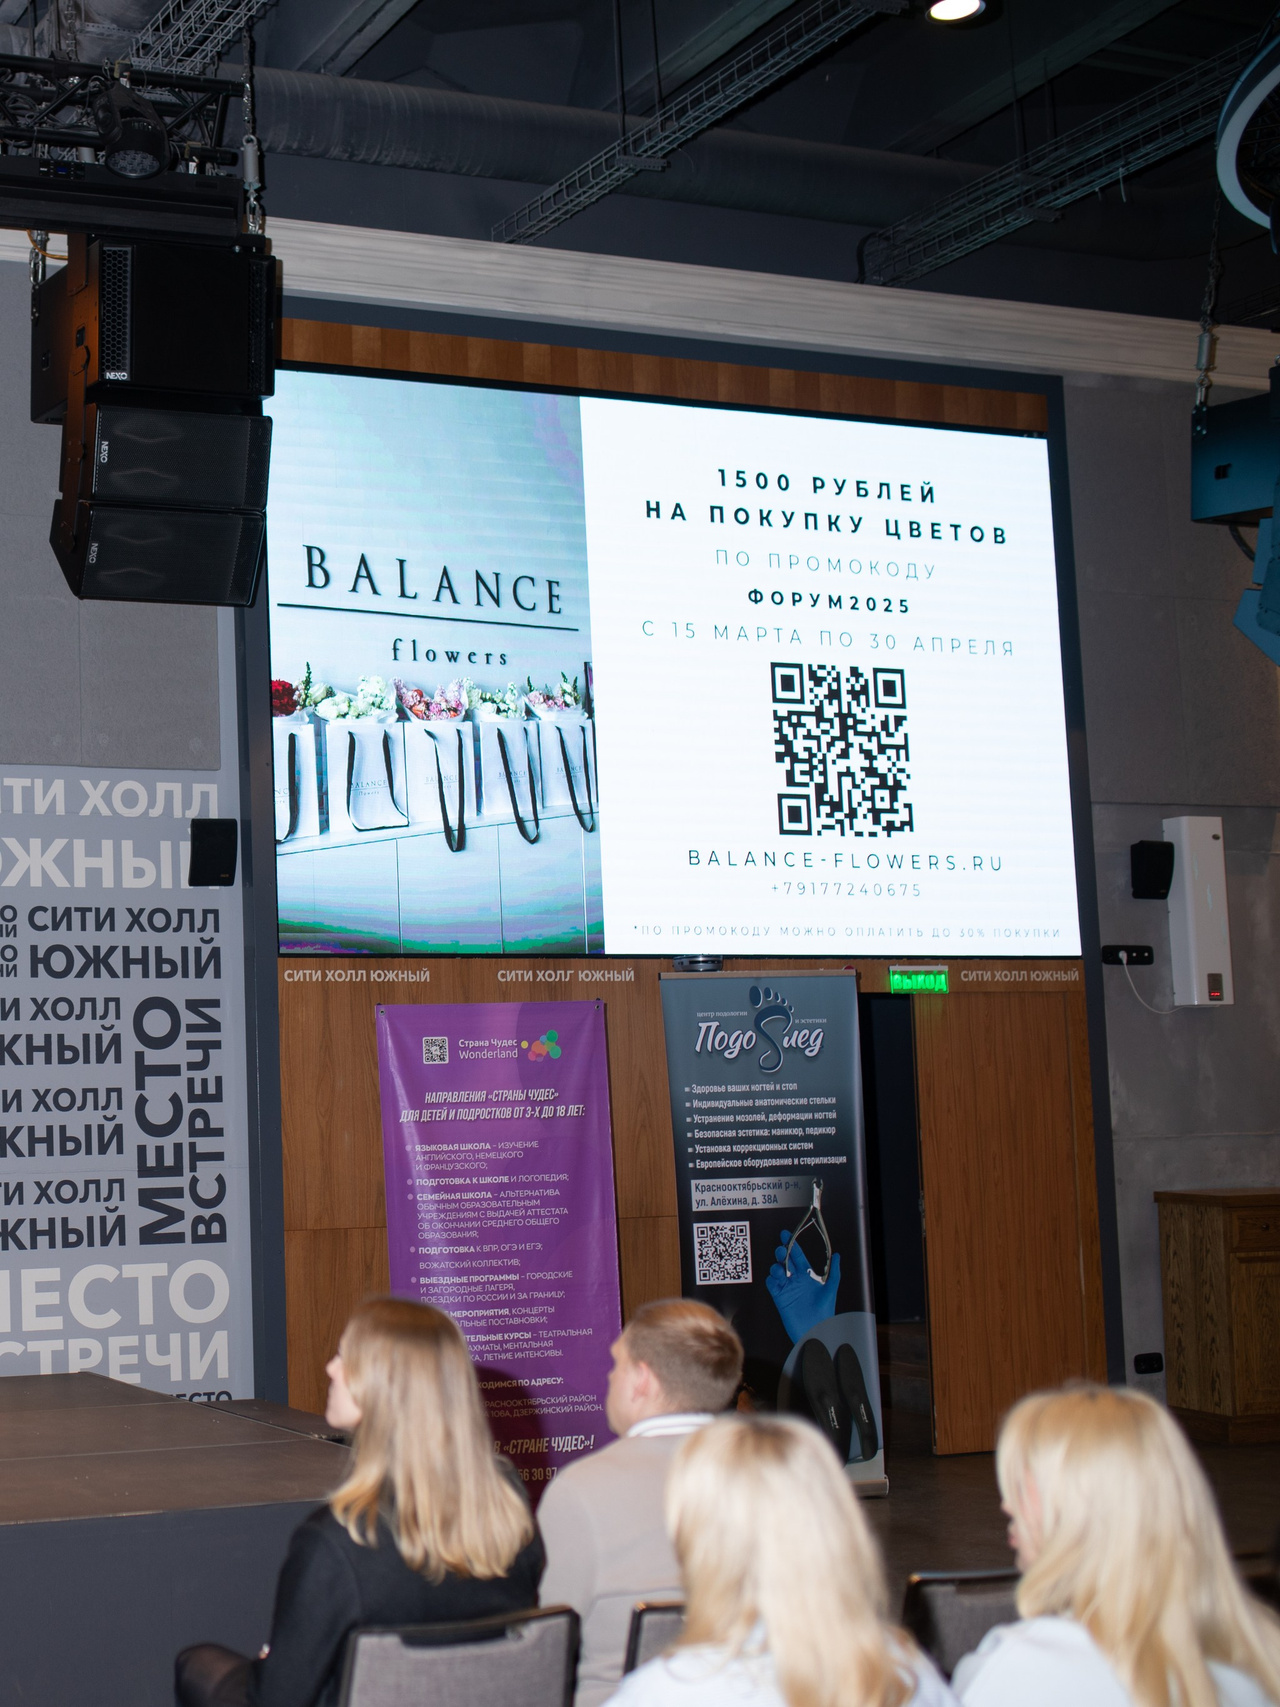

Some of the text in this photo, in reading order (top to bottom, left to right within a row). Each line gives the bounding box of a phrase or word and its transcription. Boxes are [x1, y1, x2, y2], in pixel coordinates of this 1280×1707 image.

[106, 371, 127, 380] NEXO
[100, 440, 109, 464] NEXO
[717, 468, 936, 504] 1500 РУБЛЕЙ
[646, 500, 1008, 545] НА ПОКУПКУ ЦВЕТОВ
[88, 542, 98, 564] NEXO
[715, 549, 936, 581] ПО ПРОМОКОДУ
[302, 544, 562, 614] BALANCE
[748, 588, 910, 613] ФОРУМ2025
[642, 620, 1014, 656] С 15 МАРТА ПО 30 АПРЕЛЯ
[391, 638, 507, 666] flowers
[79, 779, 219, 819] ХОЛЛ
[688, 849, 1003, 871] BALANCE-FLOWERS.RU
[771, 881, 921, 897] +79177240675
[28, 906, 220, 934] СИТИ ХОЛЛ
[671, 926, 770, 937] ПРОМОКОДУ
[780, 926, 836, 937] МОЖНО
[845, 927, 924, 938] ОПЛАТИТЬ
[932, 927, 951, 938] ДО
[993, 928, 1060, 938] ПОКУПКИ
[29, 936, 221, 979] ЮЖНЫЙ
[283, 967, 430, 983] СИТИ ХОЛЛ ЮЖНЫЙ
[497, 967, 635, 982] СИТИ ЮЖНЫЙ
[960, 968, 1080, 982] СИТИ ХОЛЛ ЮЖНЫЙ
[893, 973, 947, 991] ВЫХОД
[29, 996, 121, 1021] ХОЛЛ
[715, 1010, 748, 1018] подологии
[459, 1038, 518, 1049] Страна Чудес
[459, 1048, 518, 1060] Wonderland
[692, 1082, 797, 1094] Здоровье ваших ногтей стоп
[31, 1087, 123, 1112] ХОЛЛ
[425, 1088, 559, 1104] НАПРАВЛЕНИЯ «СТРАНЫ ЧУДЕС»
[692, 1096, 836, 1109] Индивидуальные анатомические стельки
[132, 996, 186, 1246] МЕСТО
[400, 1105, 586, 1123] ДЛЯ ДЕТЕЙ ПОДРОСТКОВ ОТ ДО 18 ЛЕТ:
[693, 1110, 837, 1124] Устранение мозолей, деформации ногтей
[184, 998, 227, 1245] ВСТРЕЧИ
[694, 1126, 836, 1138] Безопасная эстетика: маникюр, педикюр
[415, 1141, 539, 1152] ЯЗЫКОВАЯ ШКОЛА ИЗУЧЕНИЕ
[695, 1141, 813, 1154] Установка коррекционных систем
[415, 1151, 524, 1162] АНГЛИЙСКОГО, НЕМЕЦКОГО
[696, 1155, 847, 1170] Европейское оборудование стерилизация
[423, 1162, 488, 1172] ФРАНЦУЗСКОГО;
[416, 1174, 569, 1187] ПОДГОТОВКА ШКОЛЕ ЛОГОПЕДИЯ;
[695, 1179, 783, 1194] Краснооктябрьский
[33, 1178, 125, 1205] ХОЛЛ
[417, 1189, 560, 1201] СЕМЕЙНАЯ ШКОЛА АЛЬТЕРНАТИВА
[417, 1199, 541, 1211] ОБЫЧНЫМ ОБРАЗОВАТЕЛЬНЫМ
[710, 1194, 778, 1207] Алёхина, 38А
[417, 1207, 569, 1220] УЧРЕЖДЕНИЯМ ВЫДАЧЕЙ АТТЕСТАТА
[417, 1217, 560, 1230] ОБ ОКОНЧАНИИ СРЕДНЕГО ОБЩЕГО
[418, 1230, 479, 1240] ОБРАЗОВАНИЯ;
[418, 1242, 543, 1255] ПОДГОТОВКА ВПР, ОГЭ ЕГЭ;
[420, 1258, 521, 1270] ВОЖАТСКИЙ КОЛЛЕКТИВ;
[420, 1271, 573, 1284] ВЫЕЗДНЫЕ ПРОГРАММЫ ГОРОДСКИЕ
[428, 1283, 515, 1294] ЗАГОРОДНЫЕ ЛАГЕРЯ,
[420, 1290, 566, 1305] ПОЕЗДКИ ПО РОССИИ ГРАНИЦУ;
[450, 1306, 555, 1318] МЕРОПРИЯТИЯ, КОНЦЕРТЫ
[504, 1331, 531, 1340] КУРСЫ
[538, 1328, 593, 1338] ТЕАТРАЛЬНАЯ
[503, 1340, 553, 1350] МЕНТАЛЬНАЯ
[483, 1352, 514, 1361] ЛЕТНИЕ
[514, 1349, 563, 1359] ИНТЕНСИВЫ.
[531, 1377, 564, 1386] АДРЕСУ:
[569, 1394, 597, 1402] РАЙОН
[513, 1404, 603, 1418] ДЗЕРЖИНСКИЙ РАЙОН.
[503, 1434, 595, 1454] «СТРАНЕ ЧУДЕС»!
